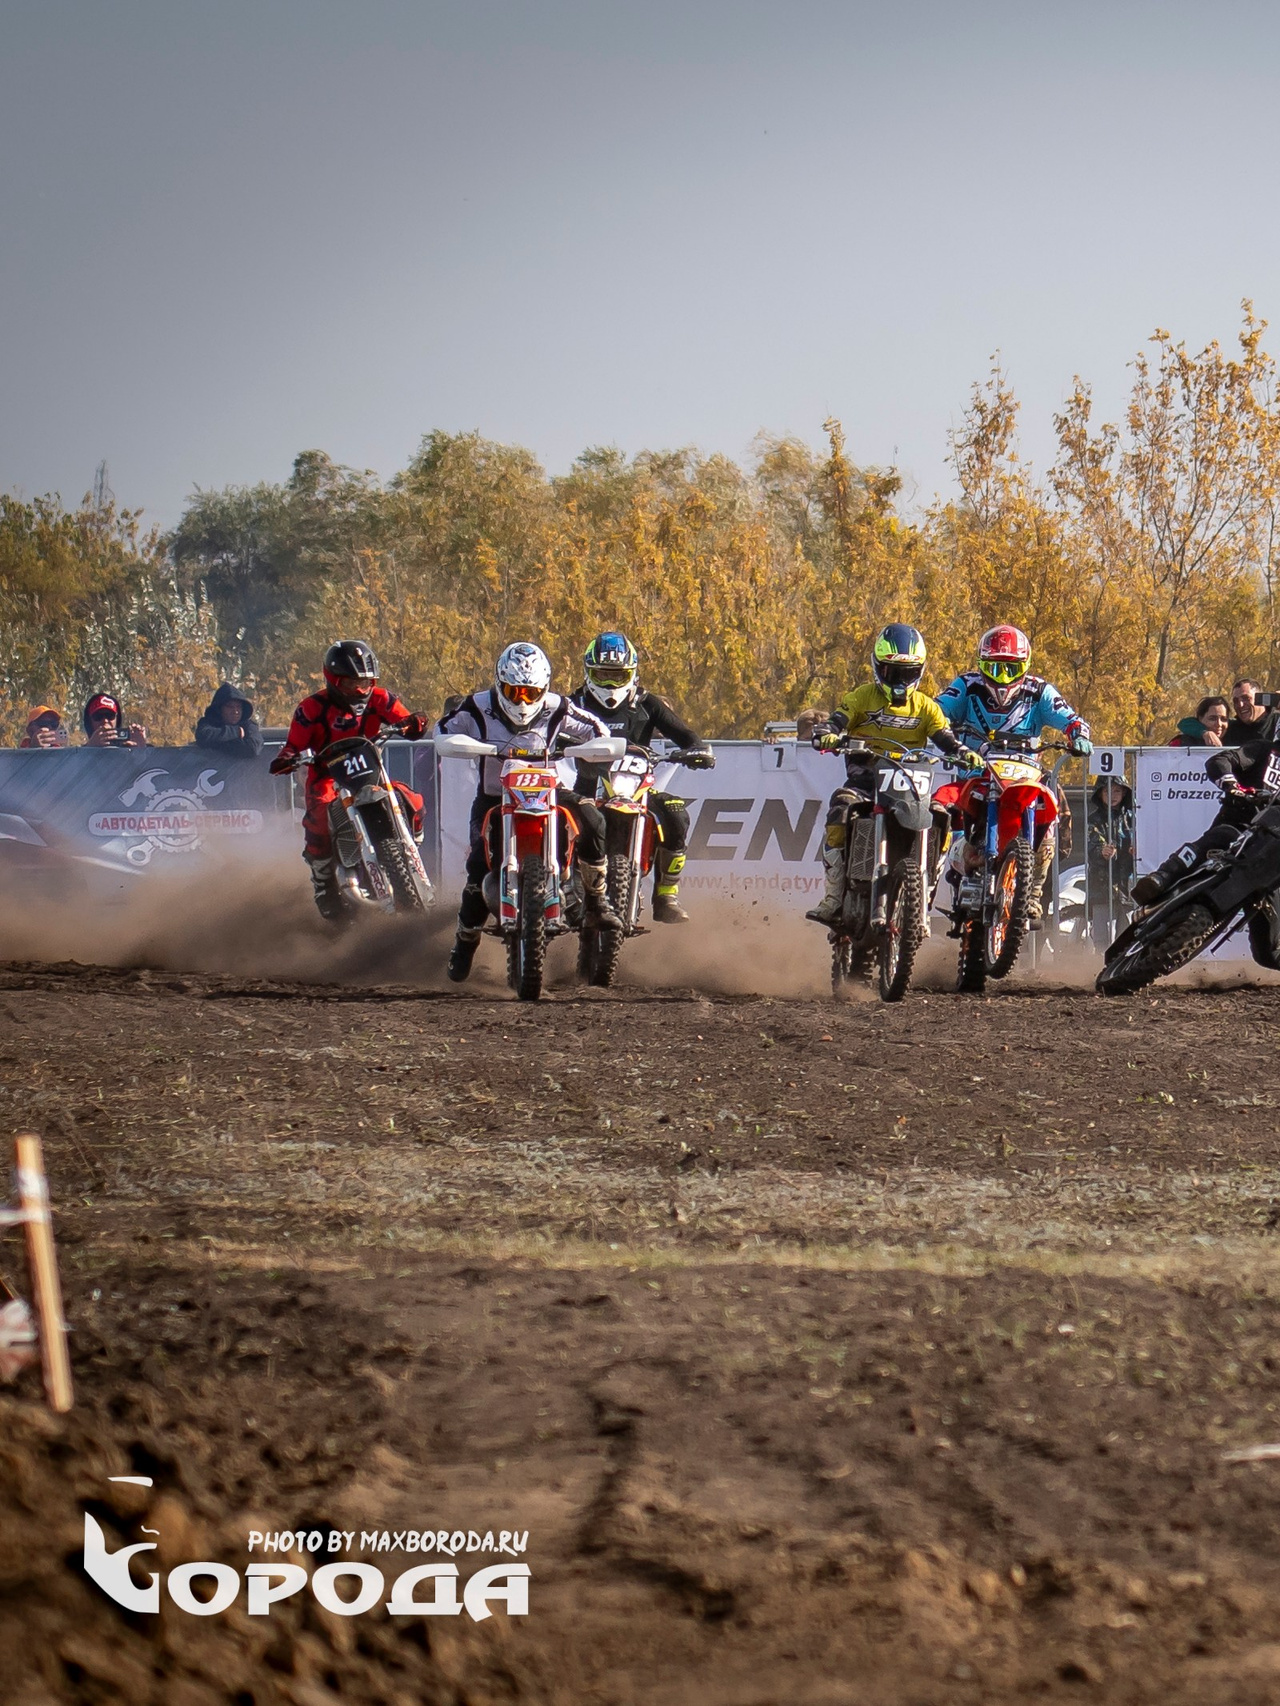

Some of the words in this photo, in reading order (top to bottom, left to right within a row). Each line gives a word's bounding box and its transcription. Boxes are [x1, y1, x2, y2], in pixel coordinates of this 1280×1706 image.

[600, 651, 626, 662] FLY
[344, 755, 368, 775] 211
[773, 748, 784, 768] 7
[1100, 752, 1114, 772] 9
[515, 774, 540, 787] 133
[878, 768, 930, 795] 765
[1167, 788, 1223, 800] brazzerz
[679, 873, 826, 893] www.kendatyr
